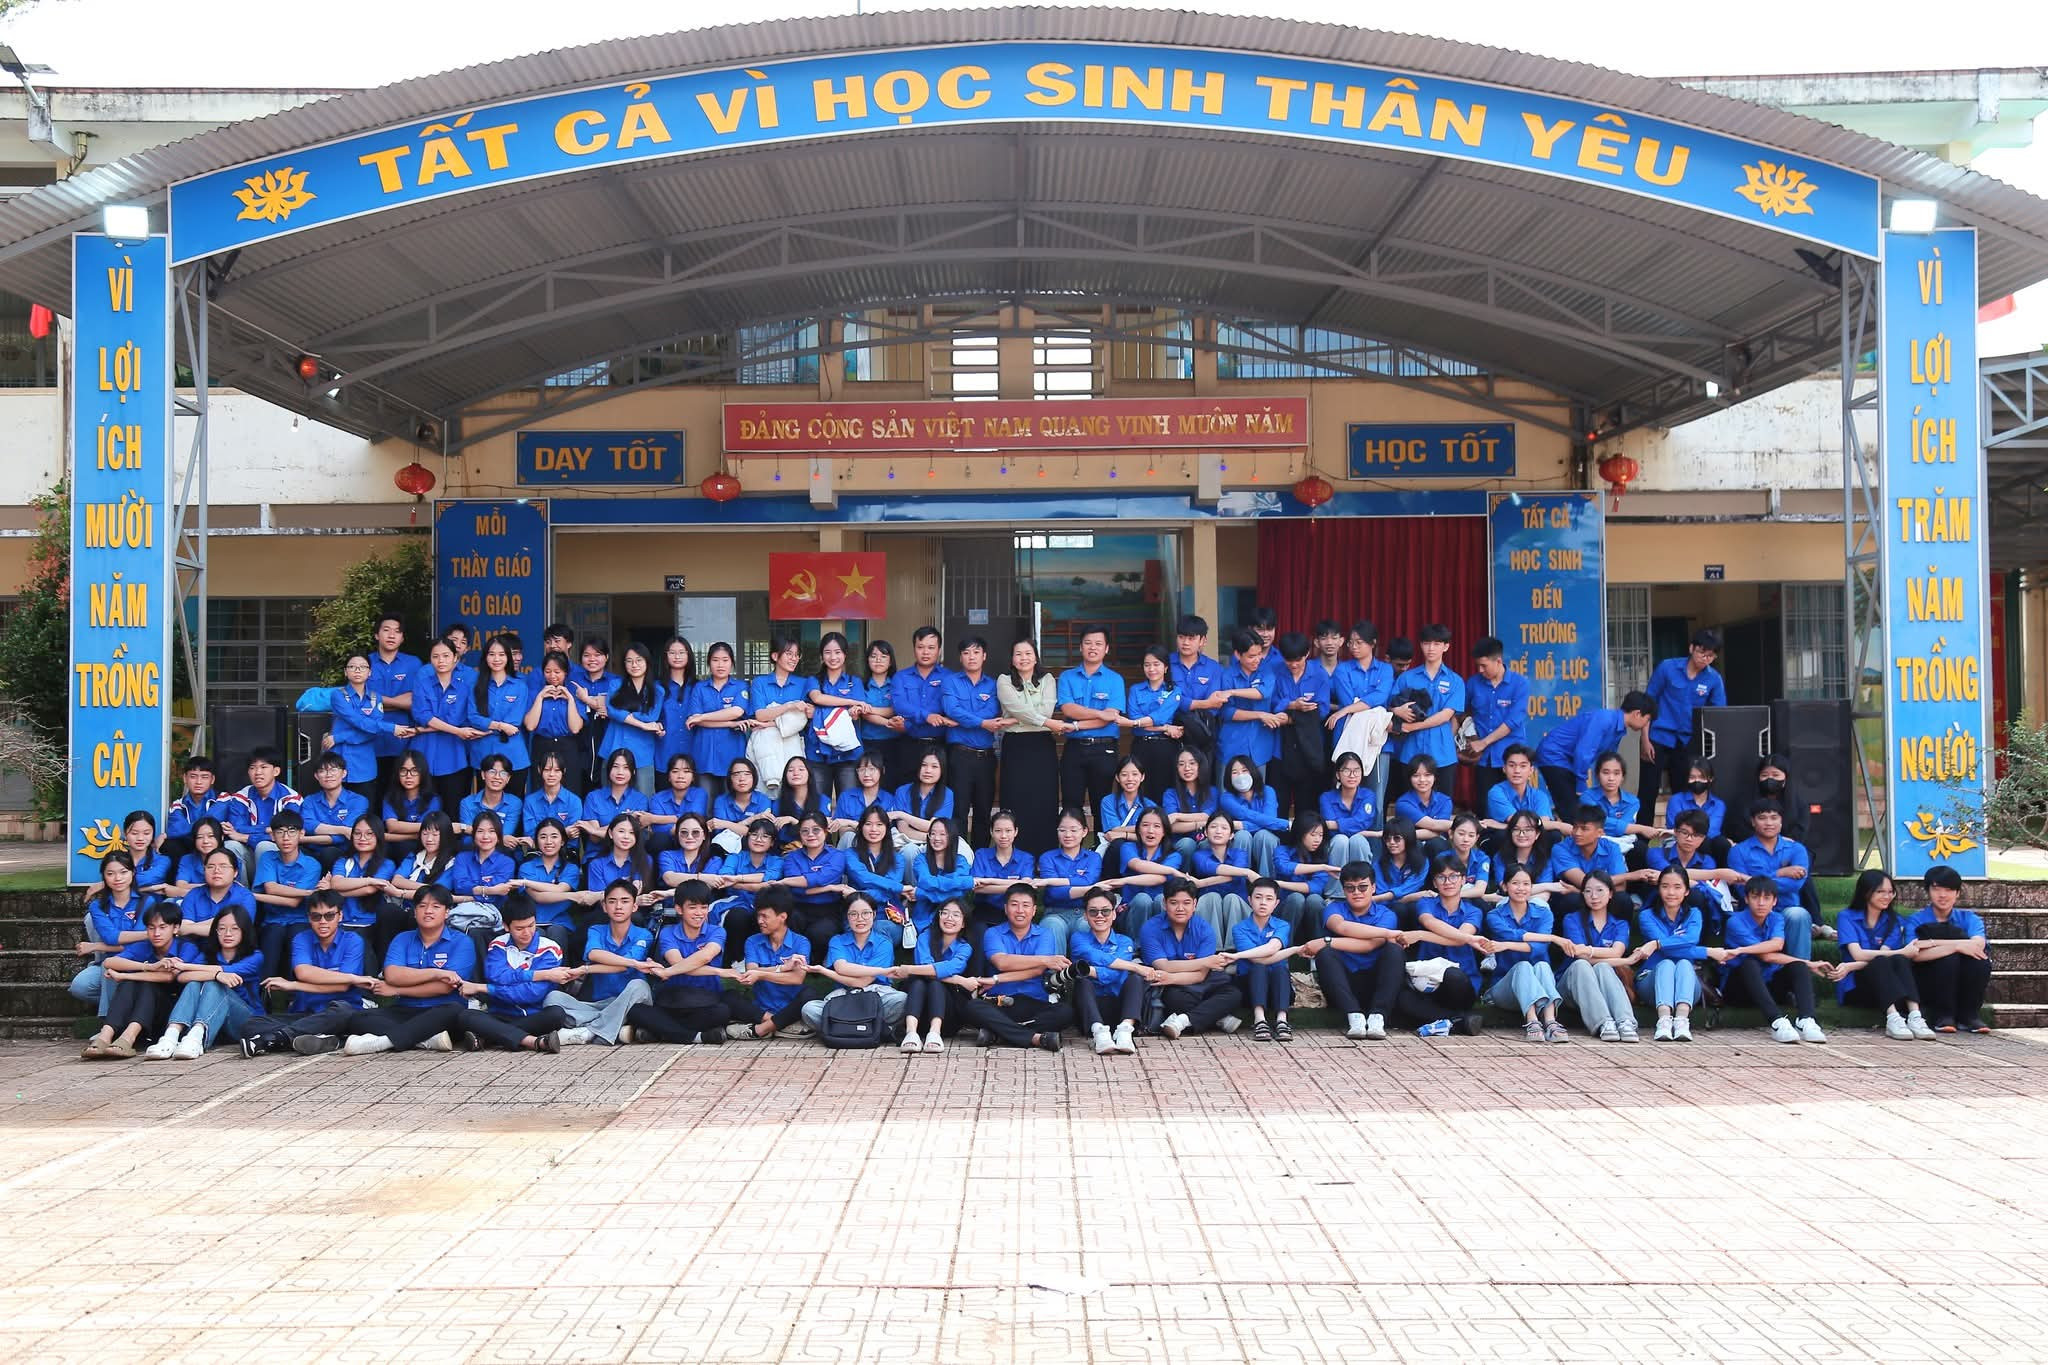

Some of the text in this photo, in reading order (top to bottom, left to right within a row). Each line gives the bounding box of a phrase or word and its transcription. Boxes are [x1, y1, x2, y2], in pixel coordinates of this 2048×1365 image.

[360, 63, 1690, 192] TẤT CẢ VÌ HỌC SINH THÂN YÊU
[108, 256, 133, 311] VÌ
[1918, 246, 1944, 304] VÌ
[98, 340, 141, 404] LỢI
[1910, 331, 1951, 396] LỢI
[97, 413, 142, 471] ÍCH
[739, 407, 1294, 444] ĐẢNG CỘNG SẢN VIỆT NAM QUANG VINH MUÔN NĂM
[1365, 430, 1499, 470] HỌC TỐT
[1911, 405, 1956, 463] ÍCH
[535, 438, 667, 478] DẠY TỐT
[86, 489, 153, 548] MƯỜI
[475, 507, 507, 536] MỖI
[1521, 502, 1546, 528] TẤT
[1897, 486, 1970, 542] TRĂM
[451, 549, 490, 578] THẦY
[1509, 549, 1582, 576] HỌC SINH
[90, 572, 147, 627] NĂM
[459, 590, 522, 616] CÔ GIÁO
[1531, 581, 1563, 609] ĐẾN
[1907, 565, 1964, 621] NĂM
[1520, 619, 1577, 644] TRƯỜNG
[75, 642, 160, 708] TRỒNG
[1535, 651, 1555, 680] NỖ
[1562, 658, 1589, 684] LỰC
[1896, 636, 1978, 702] TRỒNG
[1527, 692, 1582, 720] ỌC TẬP
[93, 729, 141, 787] CÂY
[1900, 721, 1976, 781] NGƯỜI
